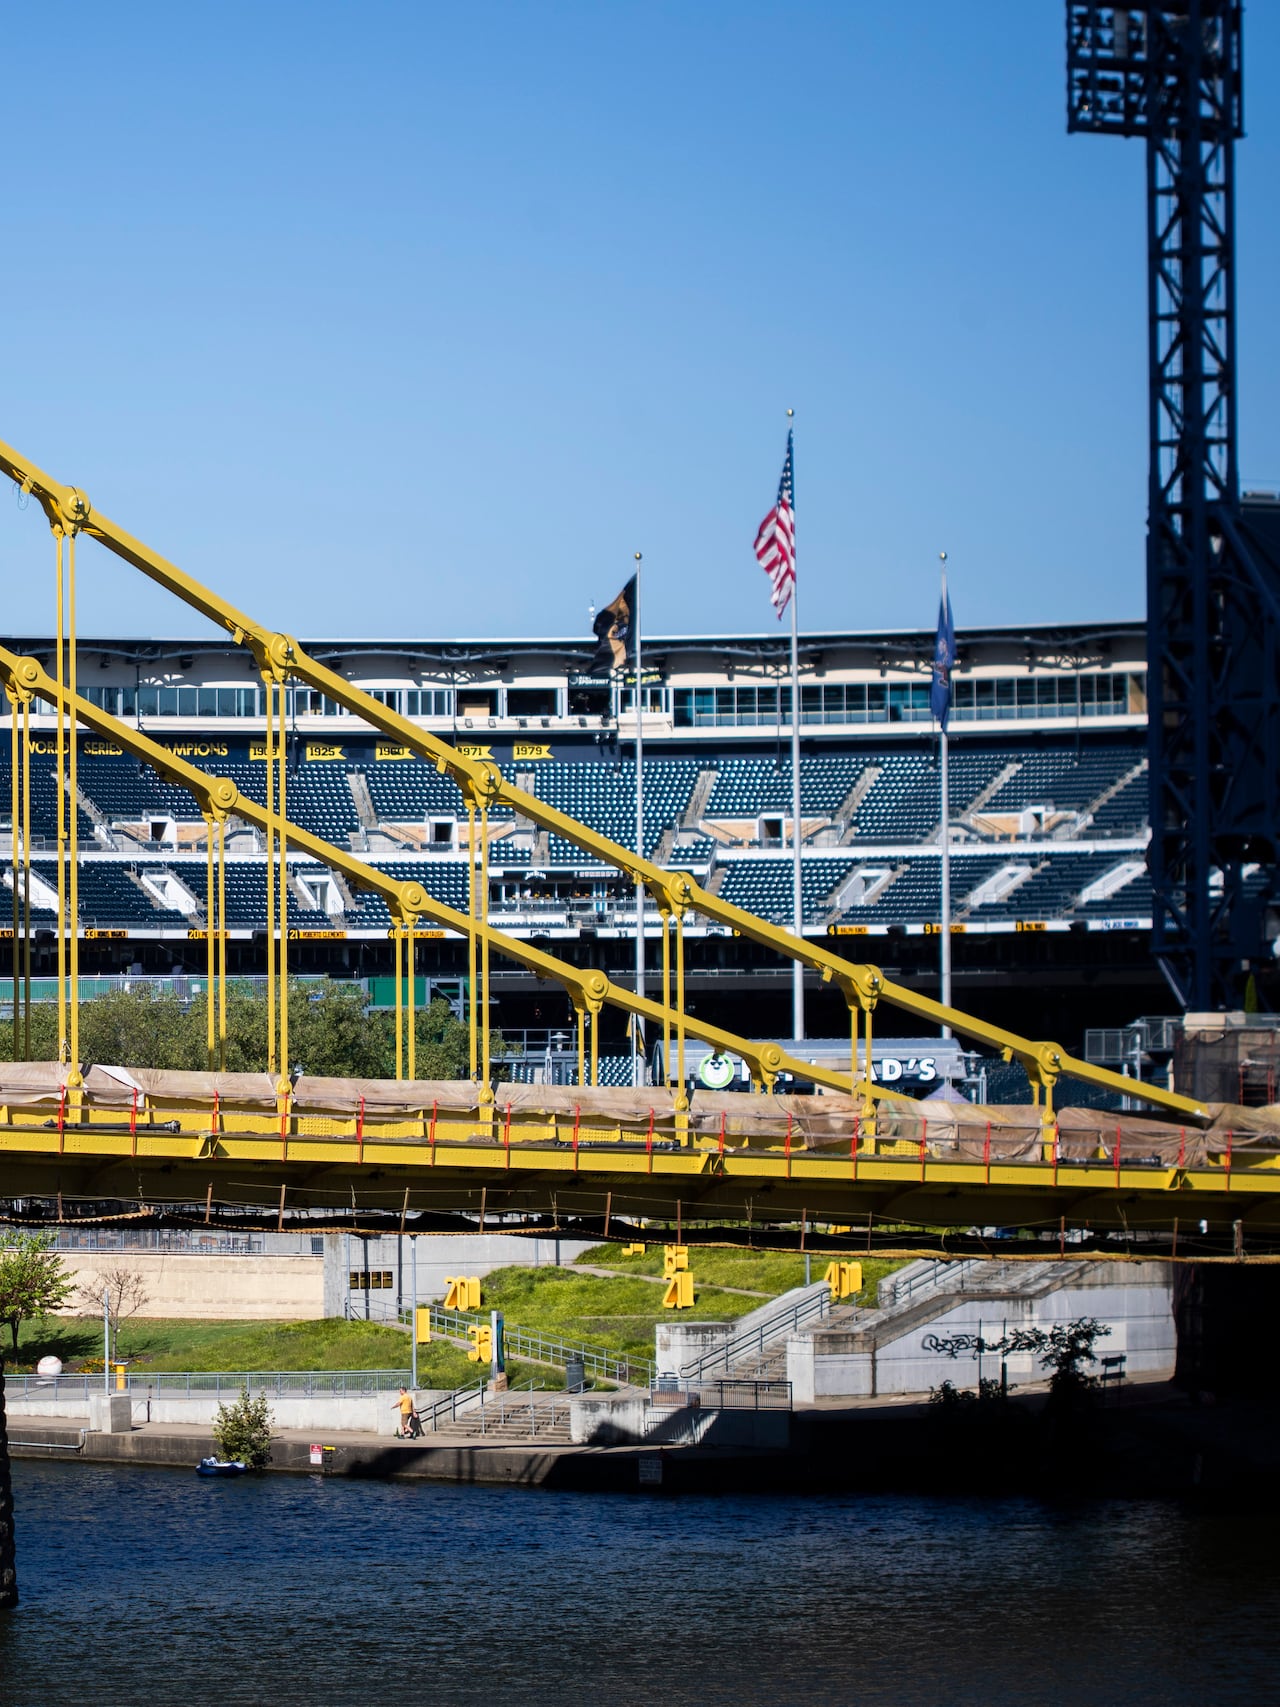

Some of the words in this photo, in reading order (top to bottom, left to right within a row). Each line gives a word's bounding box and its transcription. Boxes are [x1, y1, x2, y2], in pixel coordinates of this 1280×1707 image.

[83, 741, 123, 755] SERIES
[163, 742, 228, 756] AMPIONS
[310, 747, 335, 756] 1925
[379, 747, 404, 756] 1960
[516, 746, 543, 756] 1979
[85, 929, 95, 939] 33
[188, 929, 199, 939] 20
[289, 929, 298, 939] 21
